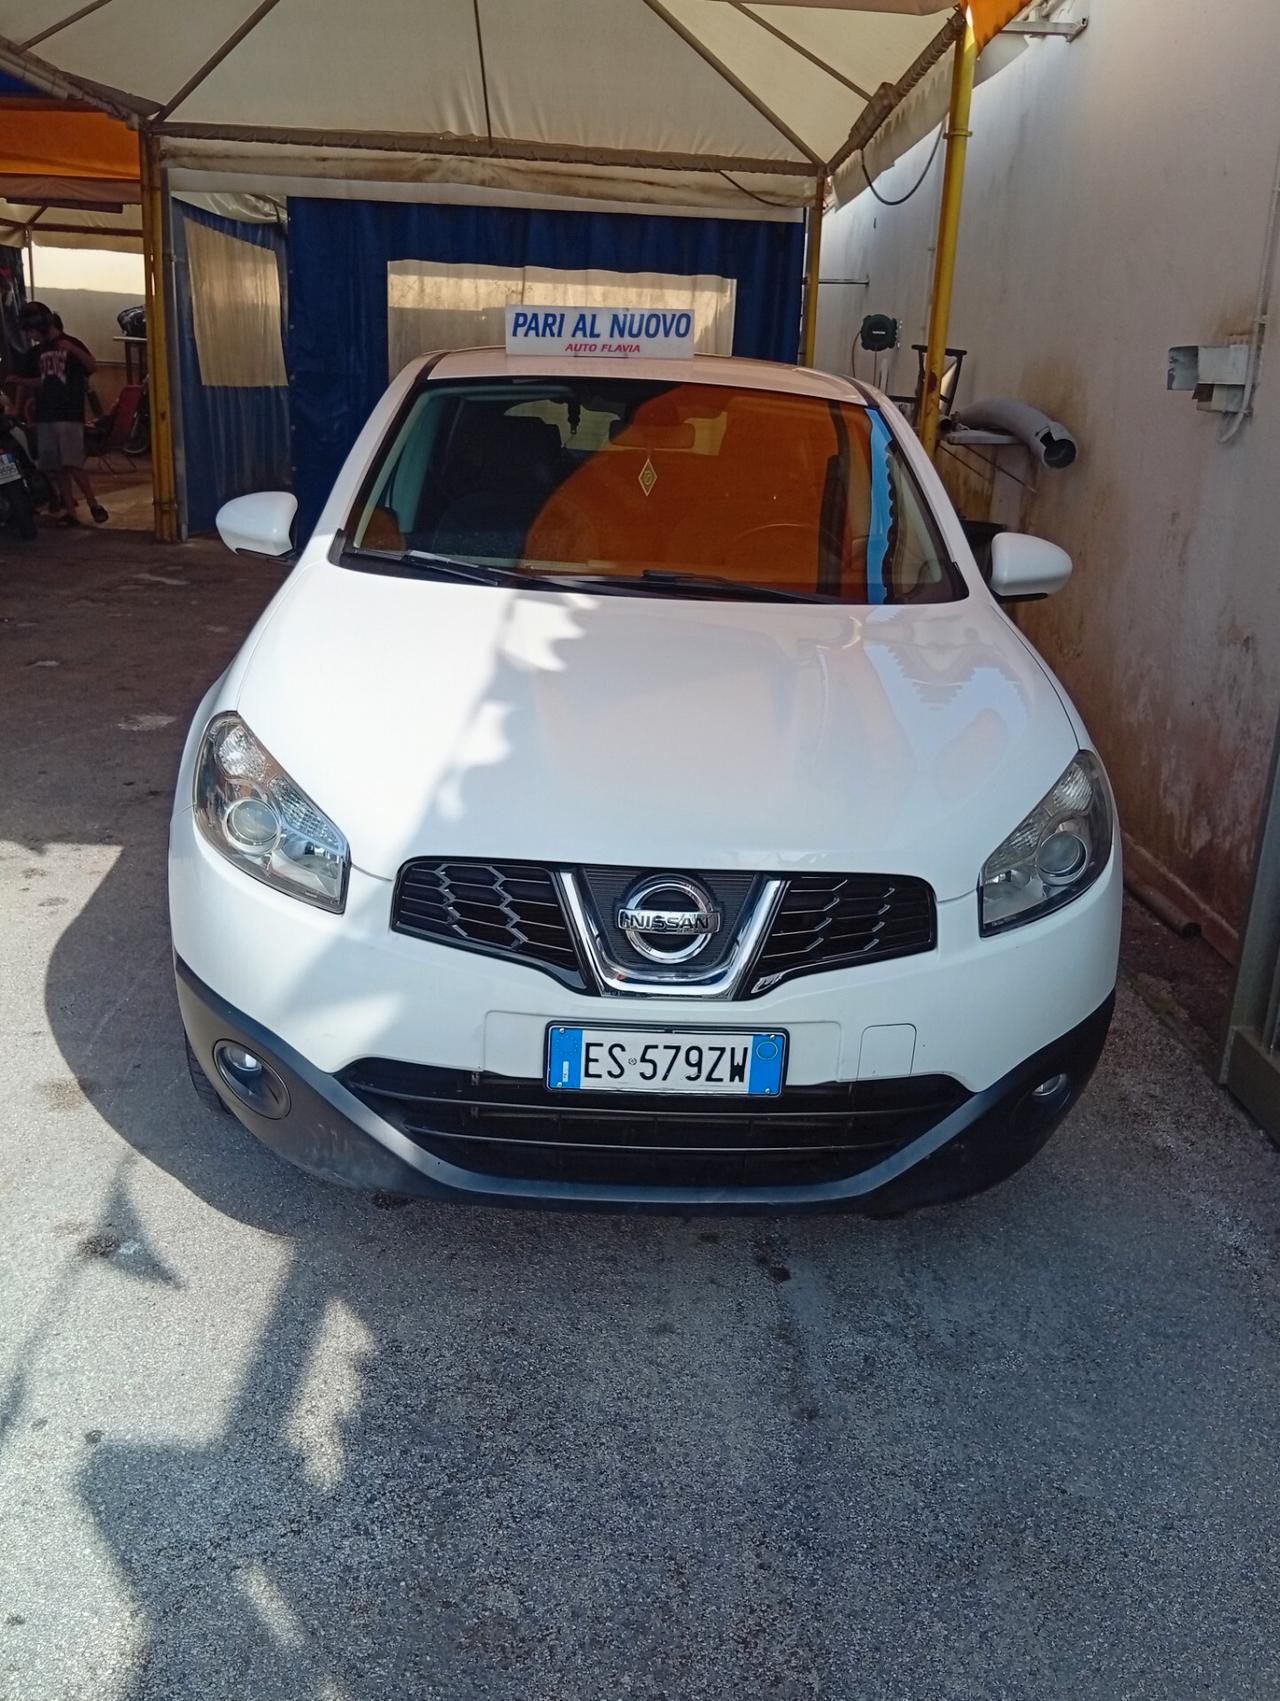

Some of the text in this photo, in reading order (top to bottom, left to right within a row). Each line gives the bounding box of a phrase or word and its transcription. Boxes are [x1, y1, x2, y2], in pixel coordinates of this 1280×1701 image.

[512, 312, 692, 338] PARI AL NUOVO
[565, 343, 641, 353] AUTO FLAVIA
[630, 914, 709, 929] NISSAN
